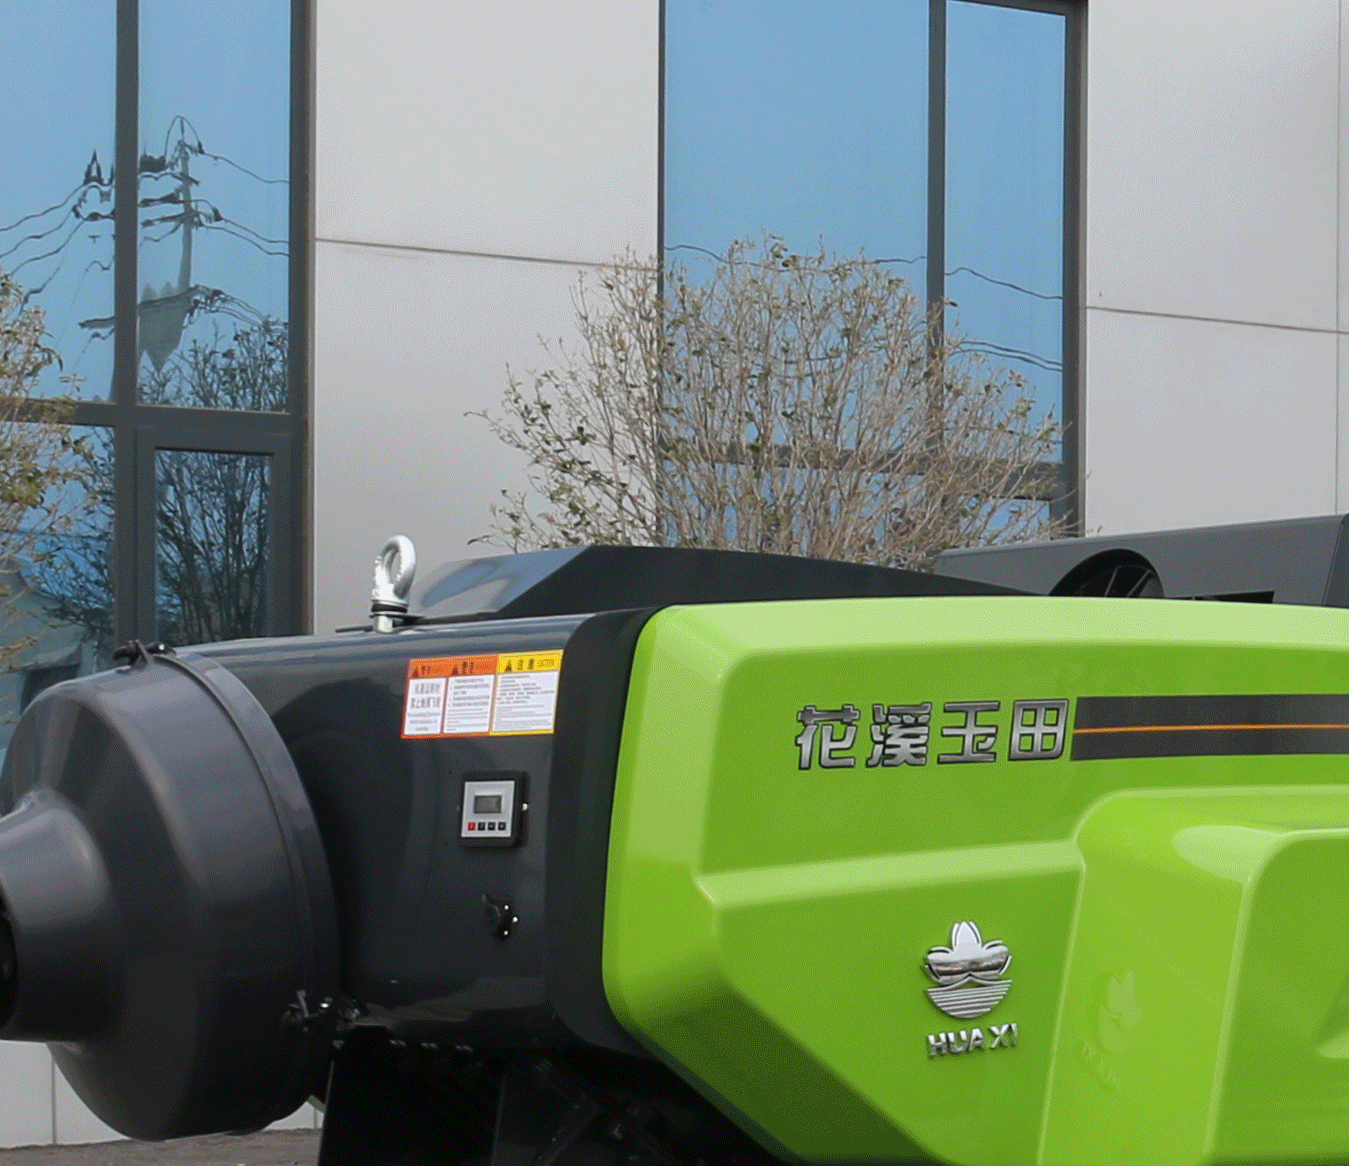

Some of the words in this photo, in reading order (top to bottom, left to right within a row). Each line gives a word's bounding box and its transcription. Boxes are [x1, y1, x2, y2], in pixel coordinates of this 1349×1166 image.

[795, 698, 1070, 770] 花溪玉田
[927, 1029, 985, 1057] HUA
[988, 1021, 1019, 1050] XI
